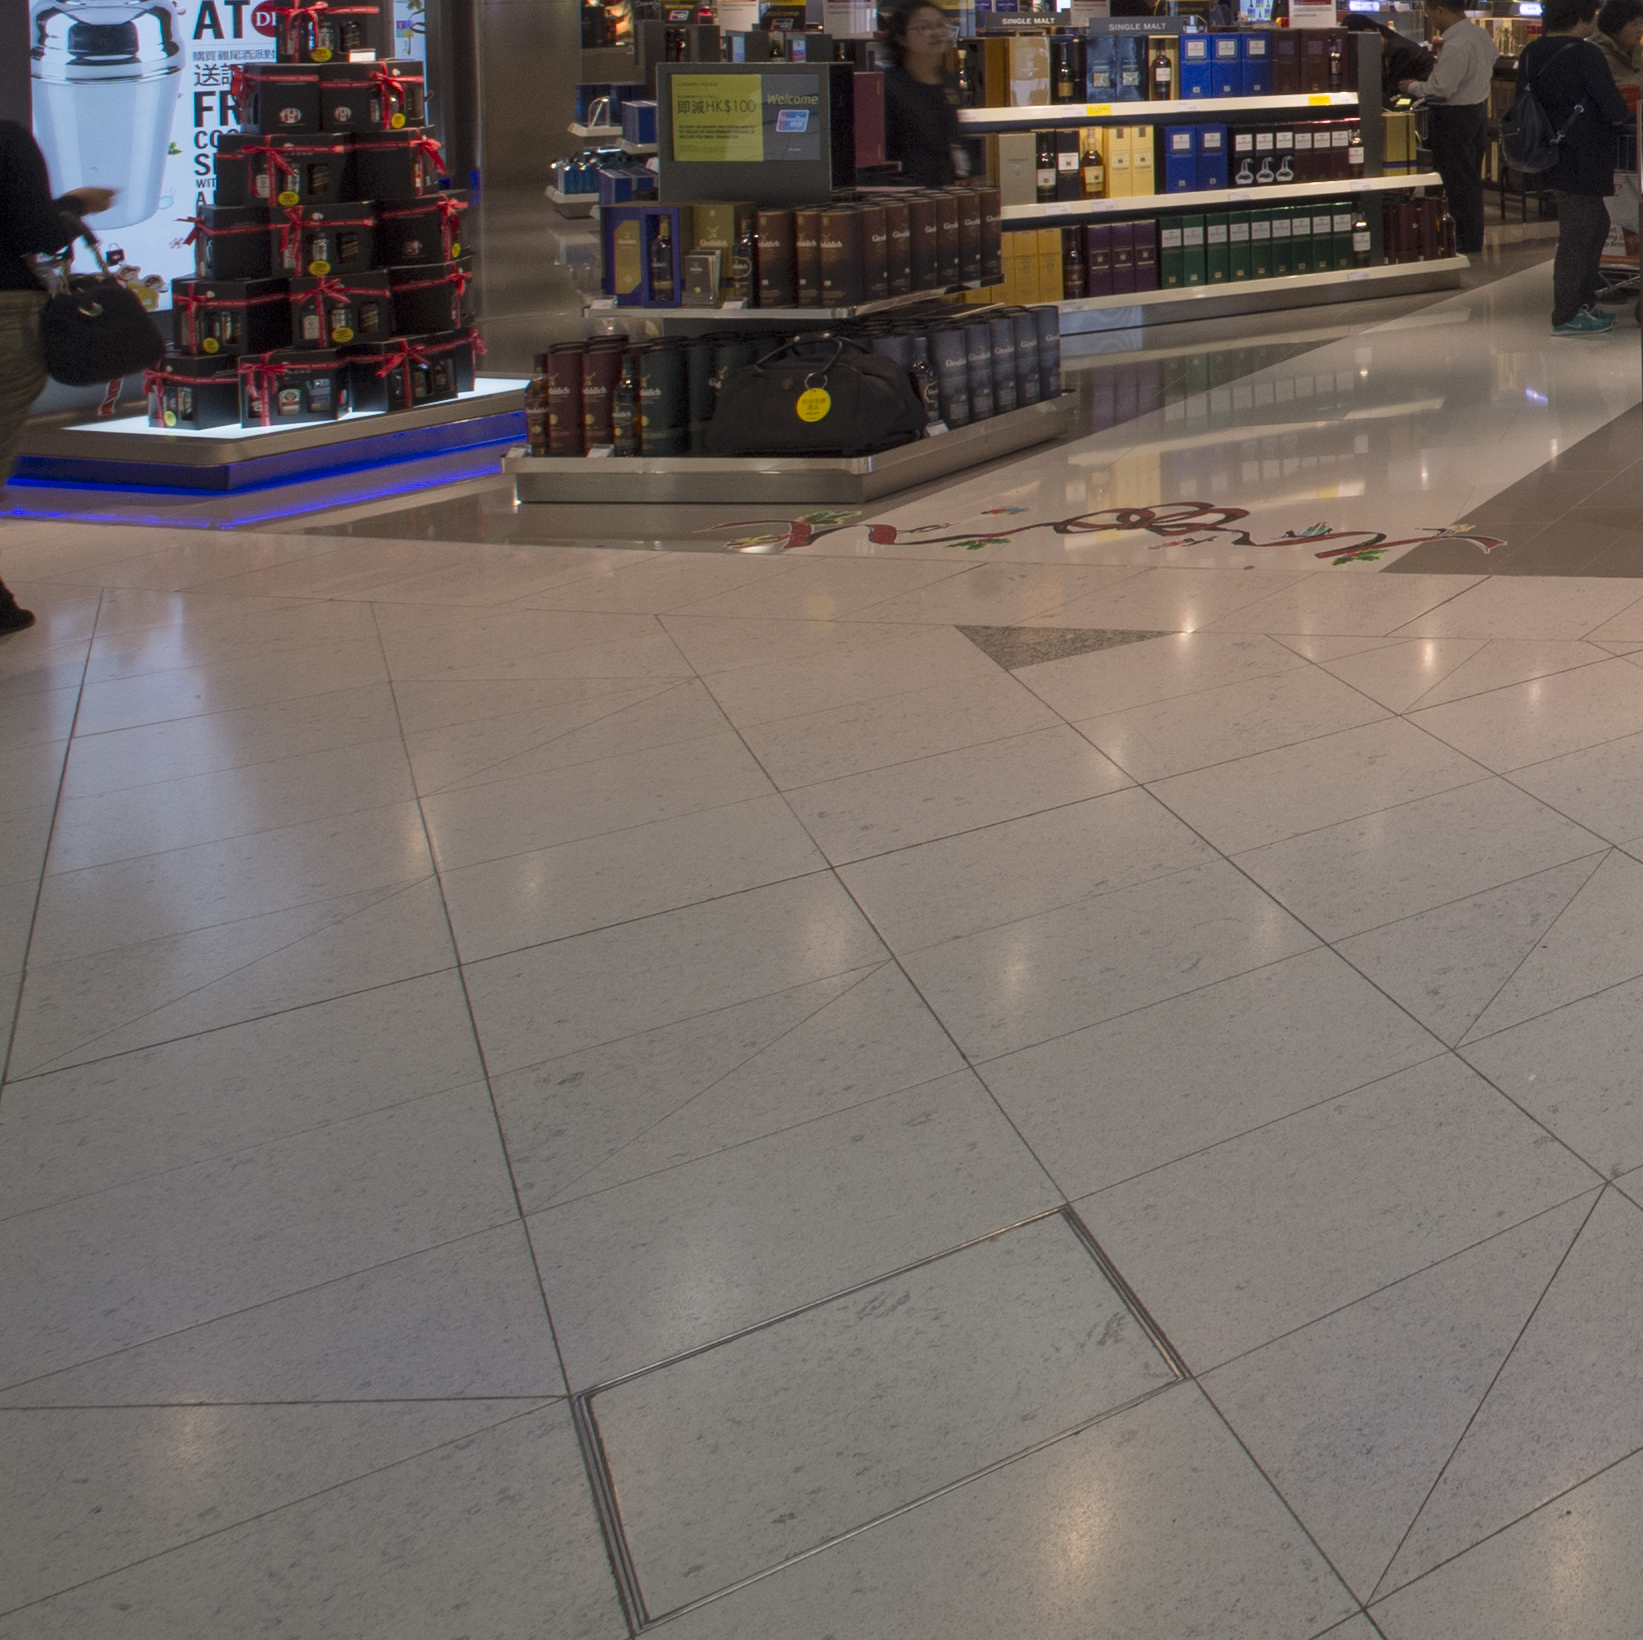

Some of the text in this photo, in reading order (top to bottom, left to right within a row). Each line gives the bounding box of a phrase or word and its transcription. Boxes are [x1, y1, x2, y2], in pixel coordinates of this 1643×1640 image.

[192, 0, 251, 40] AT
[1002, 17, 1032, 25] SINGLE
[1108, 22, 1167, 31] SINGLE MALT
[767, 93, 819, 105] Welcome
